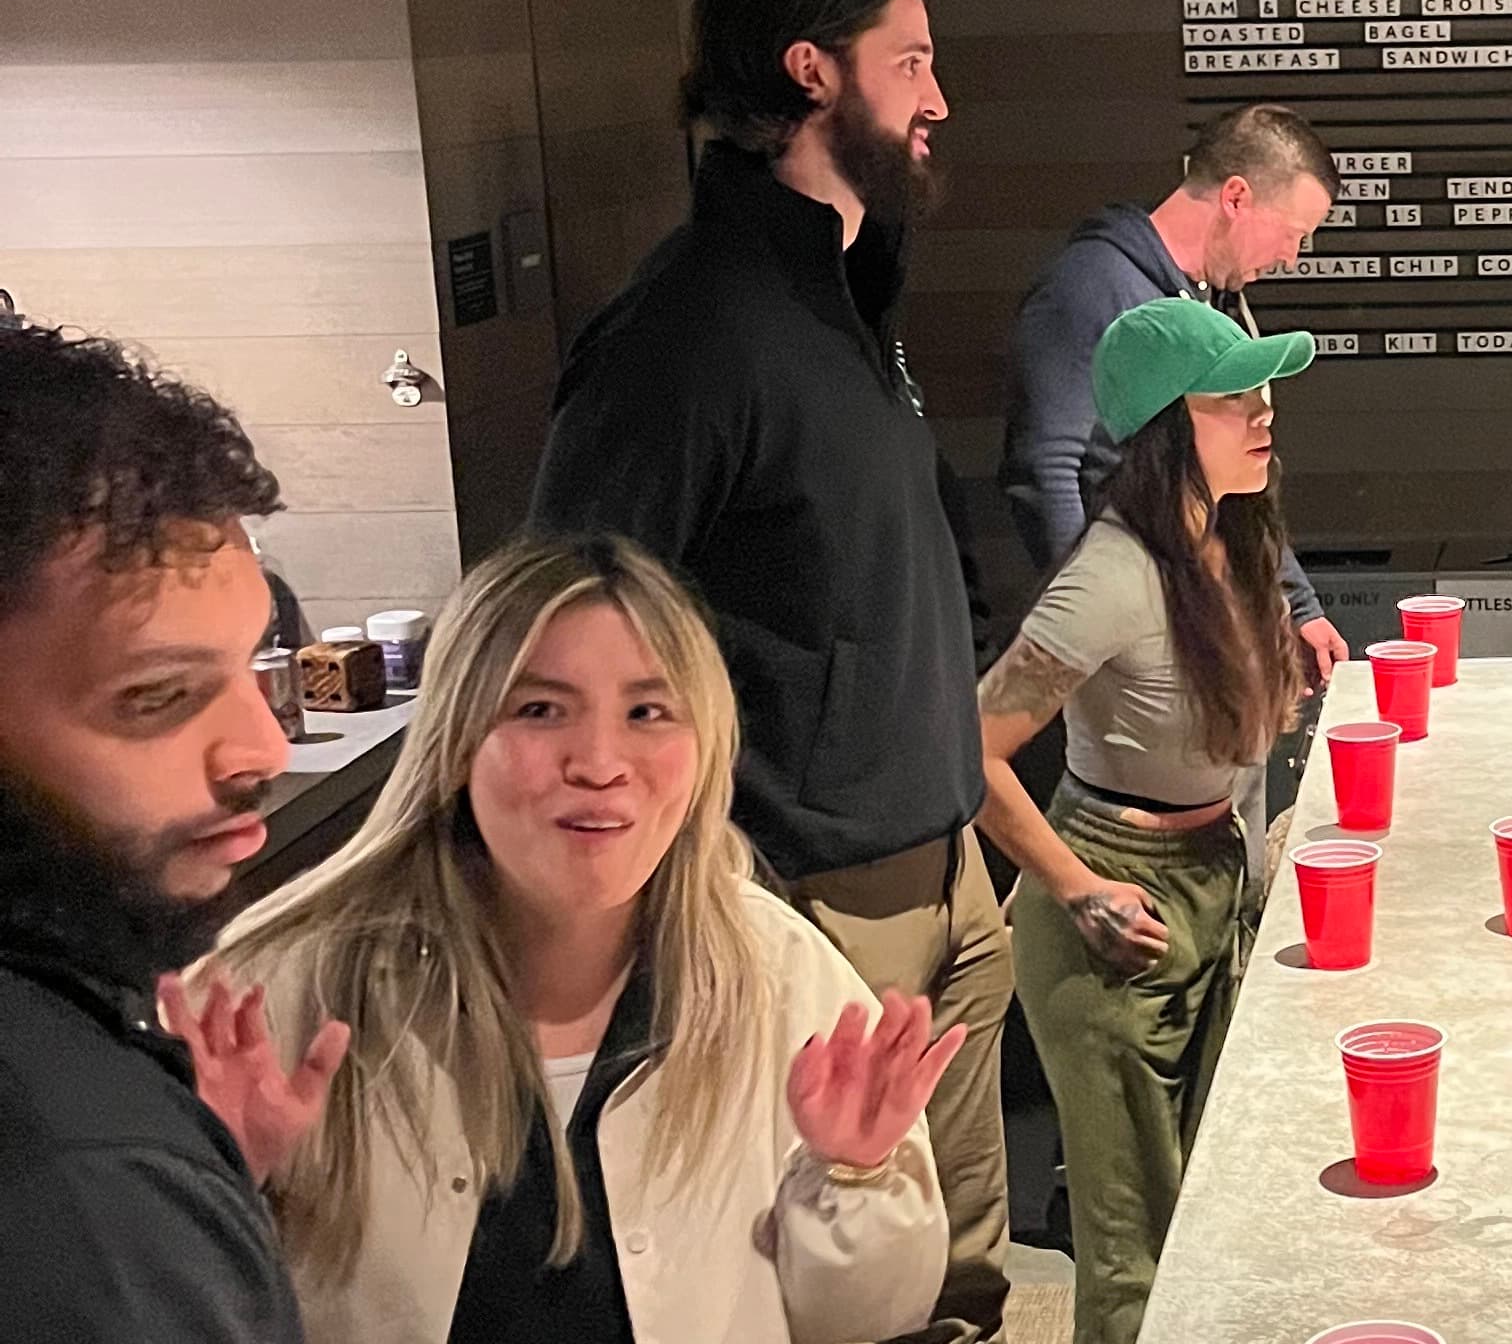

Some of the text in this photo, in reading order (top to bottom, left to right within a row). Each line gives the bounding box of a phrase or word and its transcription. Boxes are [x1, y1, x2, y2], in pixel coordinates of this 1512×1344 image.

[1187, 1, 1236, 16] HAM
[1263, 0, 1275, 14] &
[1300, 0, 1397, 14] CHEESE
[1187, 27, 1301, 43] TOASTED
[1369, 25, 1447, 40] BAGEL
[1189, 52, 1337, 69] BREAKFAST
[1336, 157, 1407, 170] RGER
[1390, 209, 1418, 222] 15
[1393, 259, 1454, 275] CHIP
[1388, 336, 1433, 350] KIT
[1340, 592, 1380, 606] ONLY
[1465, 598, 1512, 611] TTLES
